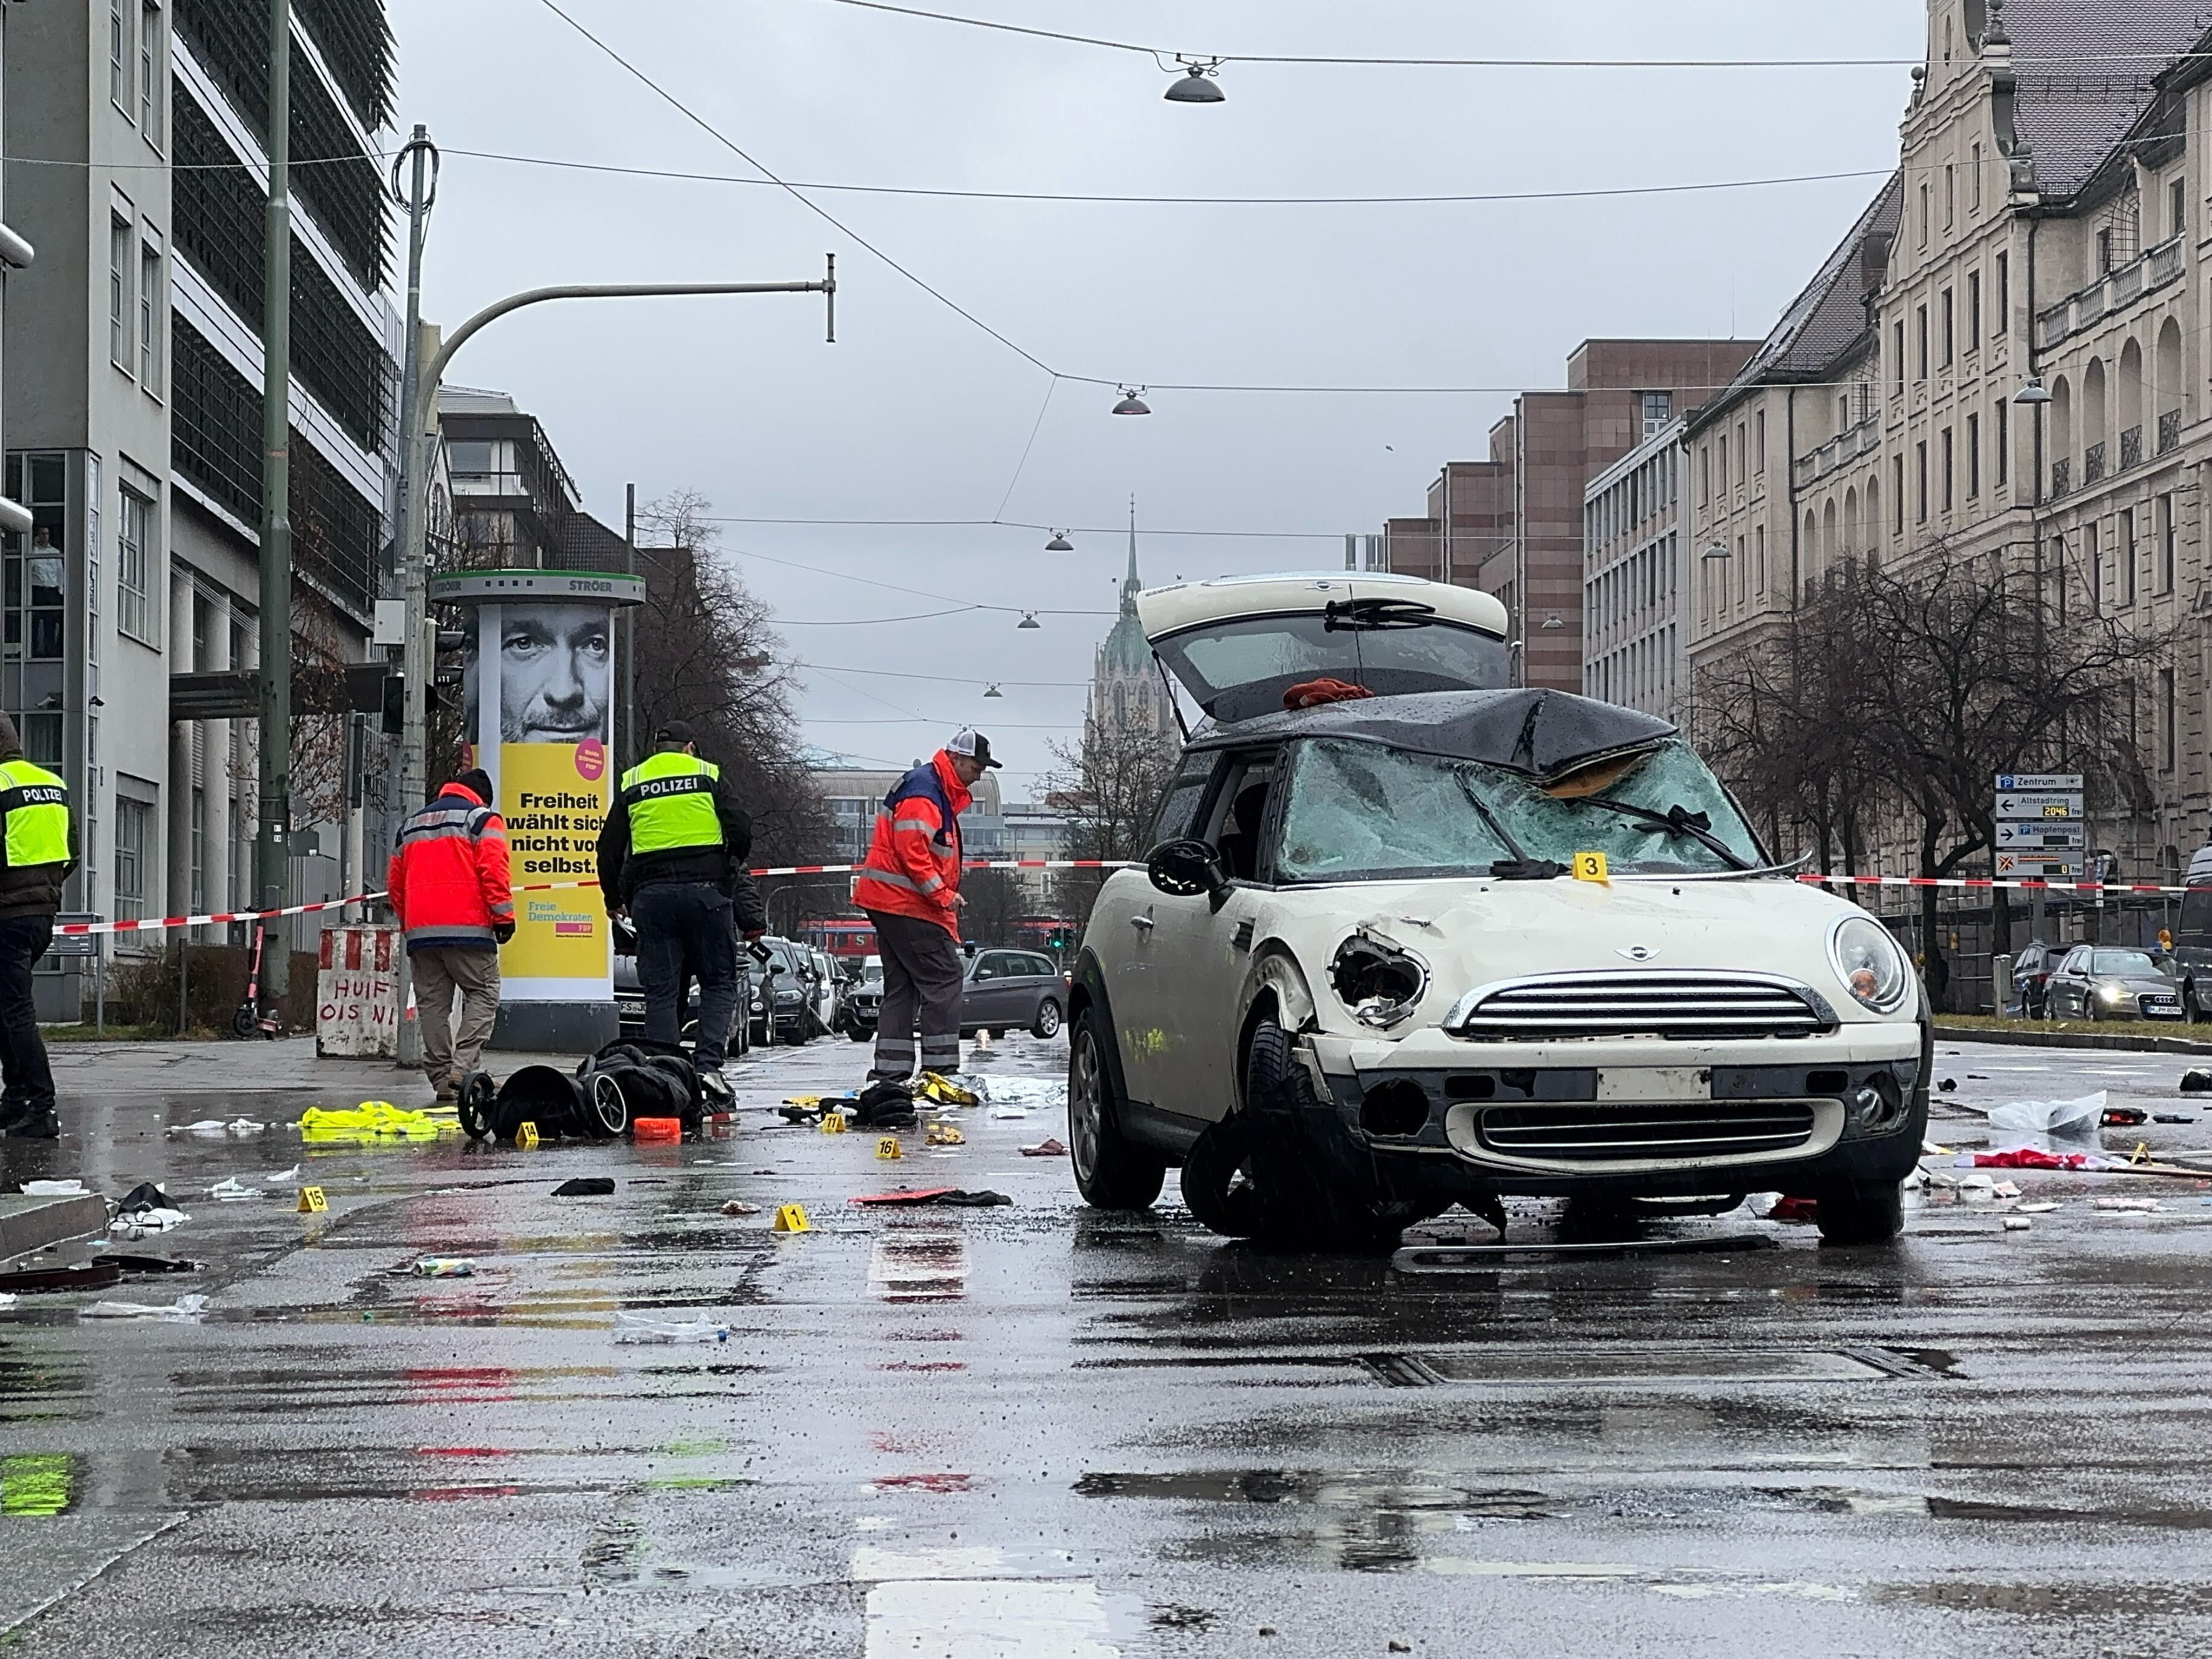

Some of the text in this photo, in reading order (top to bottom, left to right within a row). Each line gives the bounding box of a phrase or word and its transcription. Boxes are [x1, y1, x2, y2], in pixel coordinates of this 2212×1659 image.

[569, 580, 612, 592] STRÖER
[640, 778, 698, 796] POLIZEI
[2018, 777, 2056, 785] Zentrum
[521, 793, 599, 810] Freiheit
[2020, 796, 2070, 806] Altstadtring
[2044, 807, 2068, 816] 2046
[505, 814, 569, 830] wählt
[2033, 826, 2080, 834] Hopfenpost
[512, 836, 569, 851] nicht
[524, 857, 596, 874] selbst.
[1584, 857, 1598, 875] 3
[2061, 864, 2068, 874] 0
[528, 901, 557, 911] Freie
[528, 912, 593, 922] Demokraten
[856, 935, 865, 945] S
[620, 1002, 632, 1011] FS
[827, 1116, 837, 1128] 11
[525, 1125, 536, 1137] 14
[880, 1141, 893, 1154] 16
[309, 1190, 324, 1207] 15
[790, 1208, 801, 1226] 1
